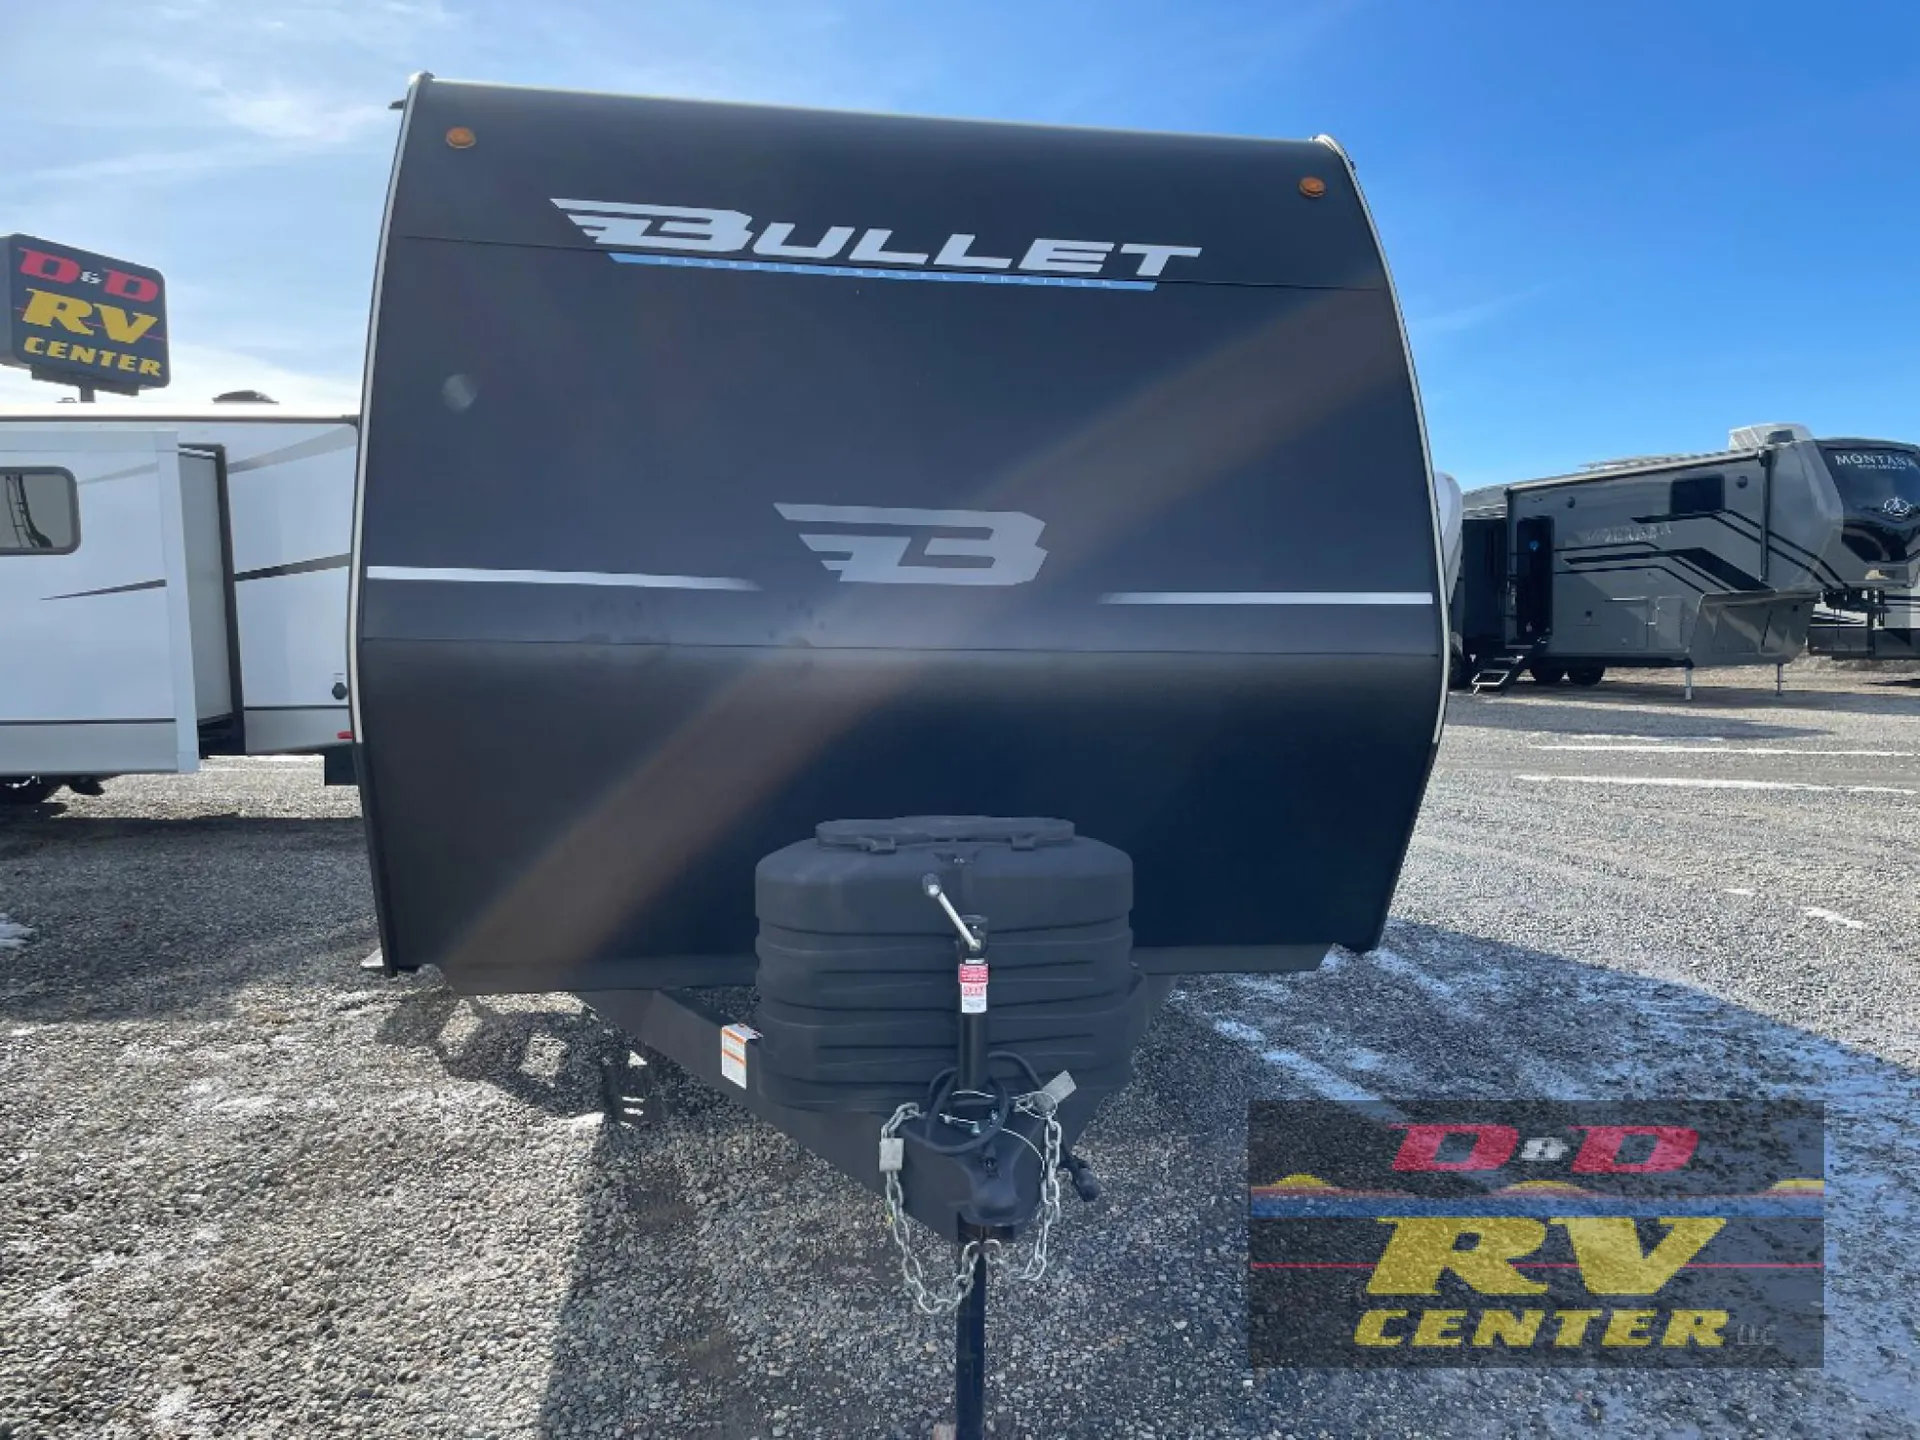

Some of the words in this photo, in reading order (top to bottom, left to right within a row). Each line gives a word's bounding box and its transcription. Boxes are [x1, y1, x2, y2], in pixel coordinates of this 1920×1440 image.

[549, 198, 1202, 276] BULLET
[18, 247, 159, 303] D&D
[22, 288, 159, 344] RV
[24, 336, 162, 377] CENTER
